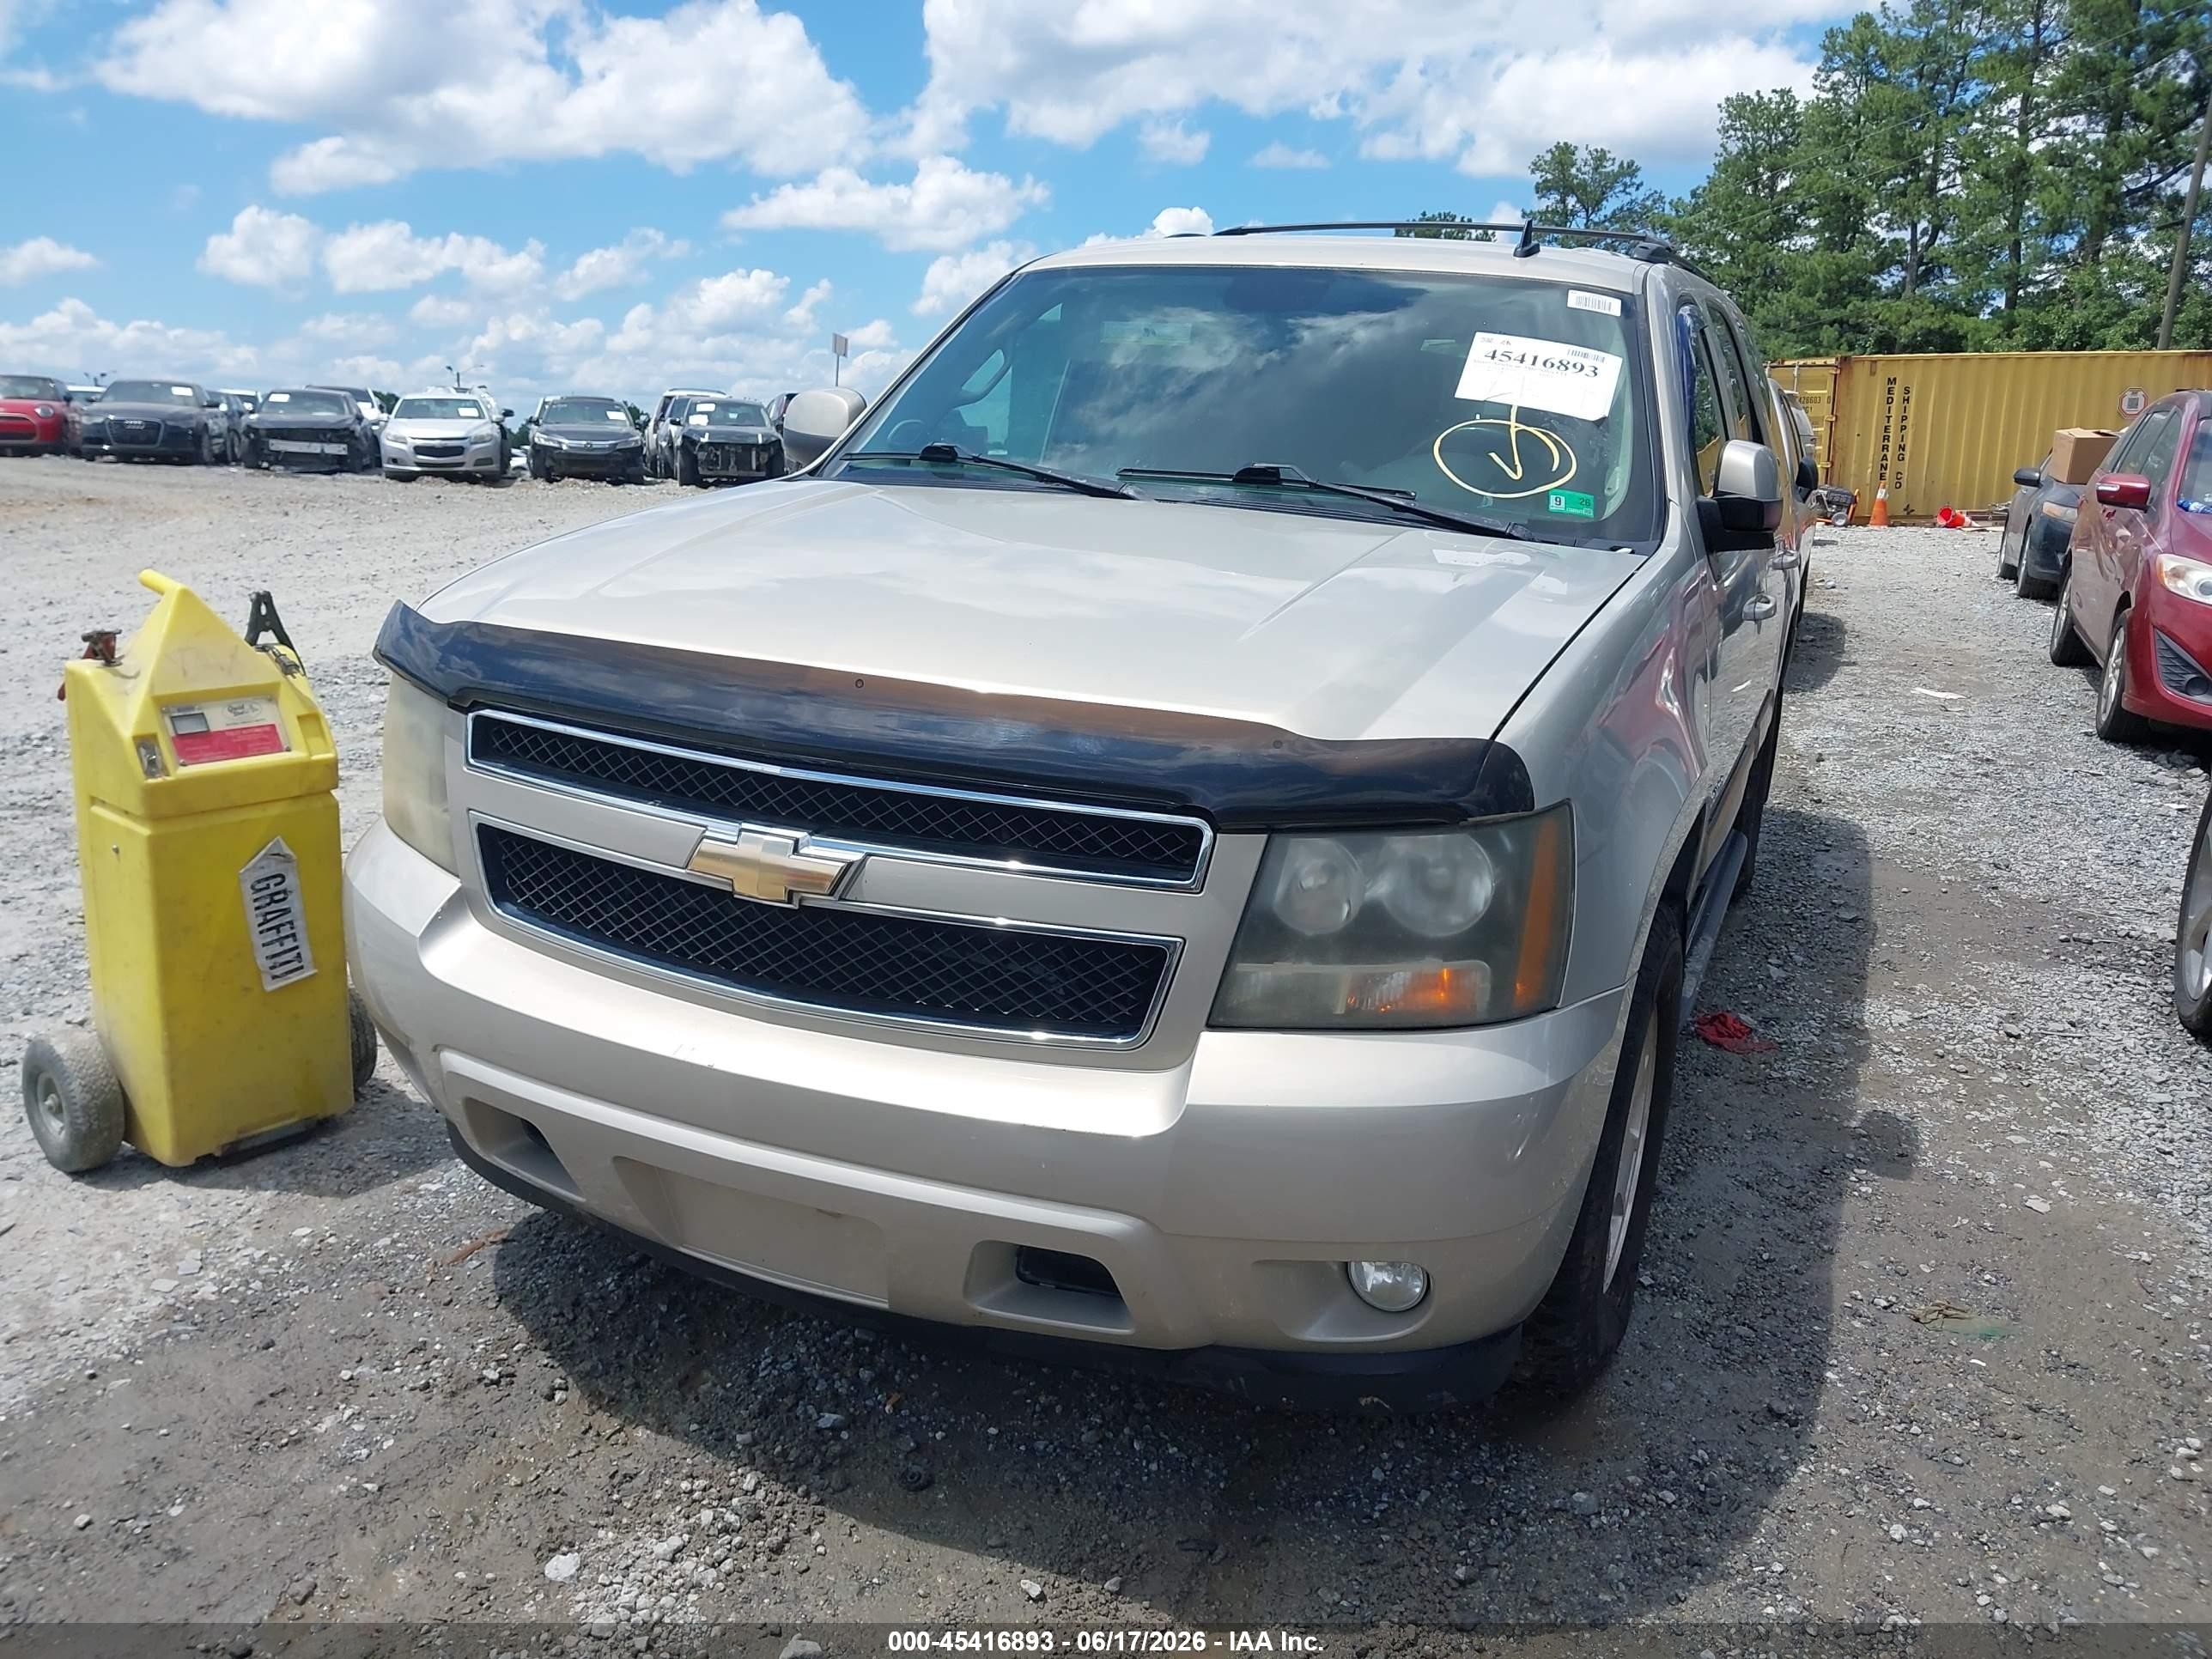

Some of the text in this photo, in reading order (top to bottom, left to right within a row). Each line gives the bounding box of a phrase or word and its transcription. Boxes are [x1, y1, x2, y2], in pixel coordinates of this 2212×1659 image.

[1484, 349, 1599, 378] 45416893
[1894, 386, 1911, 489] SHIPPING CO
[1554, 496, 1562, 506] 9
[1579, 497, 1591, 507] 26
[250, 872, 305, 981] GRAFFITI
